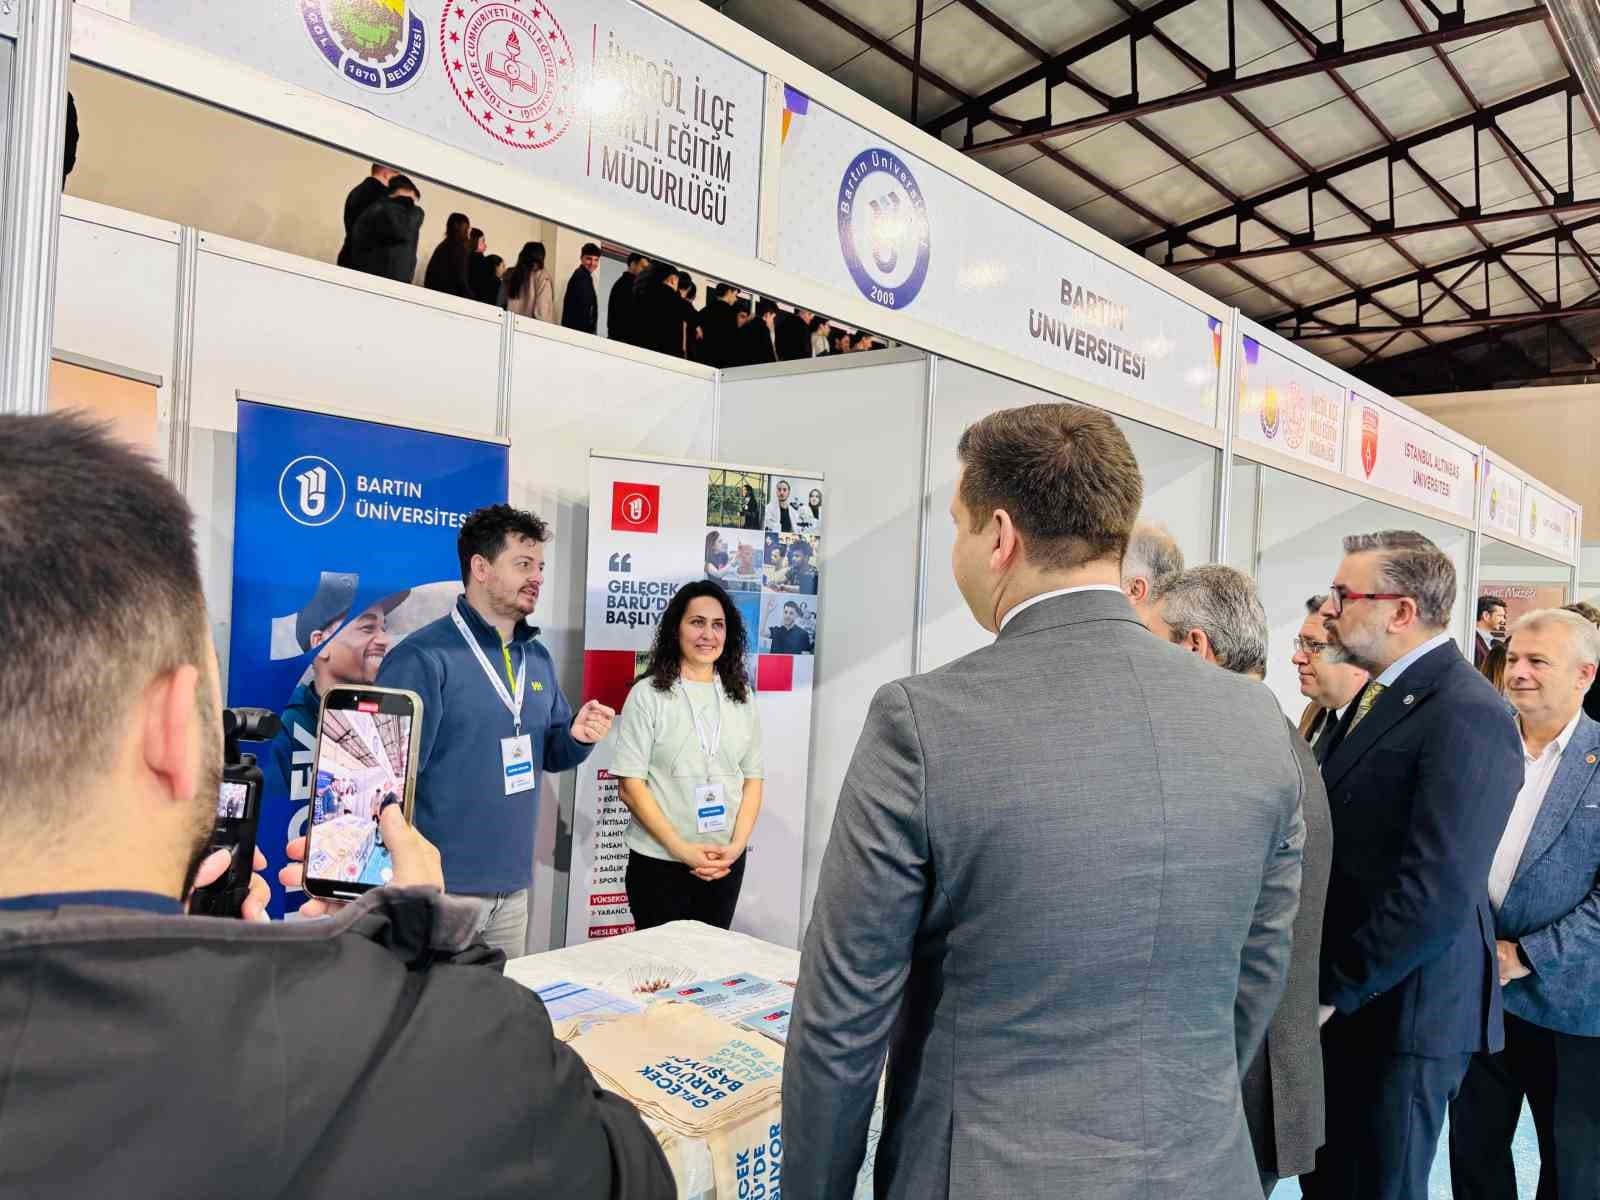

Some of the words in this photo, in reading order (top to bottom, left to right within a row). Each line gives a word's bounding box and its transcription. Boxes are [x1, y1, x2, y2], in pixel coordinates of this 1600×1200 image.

[349, 65, 377, 82] 1870
[470, 62, 502, 109] TÜRKİYE
[694, 76, 736, 140] İLÇE
[667, 121, 731, 183] EĞİTİM
[601, 144, 727, 226] MÜDÜRLÜĞÜ
[840, 161, 867, 214] Bartın
[870, 285, 895, 306] 2008
[1029, 308, 1146, 380] ÜNİVERSİTESİ
[356, 475, 422, 499] BARTIN
[355, 499, 472, 528] ÜNİVERSİTES
[607, 580, 679, 597] GELECEK
[636, 1065, 710, 1109] GELECEK
